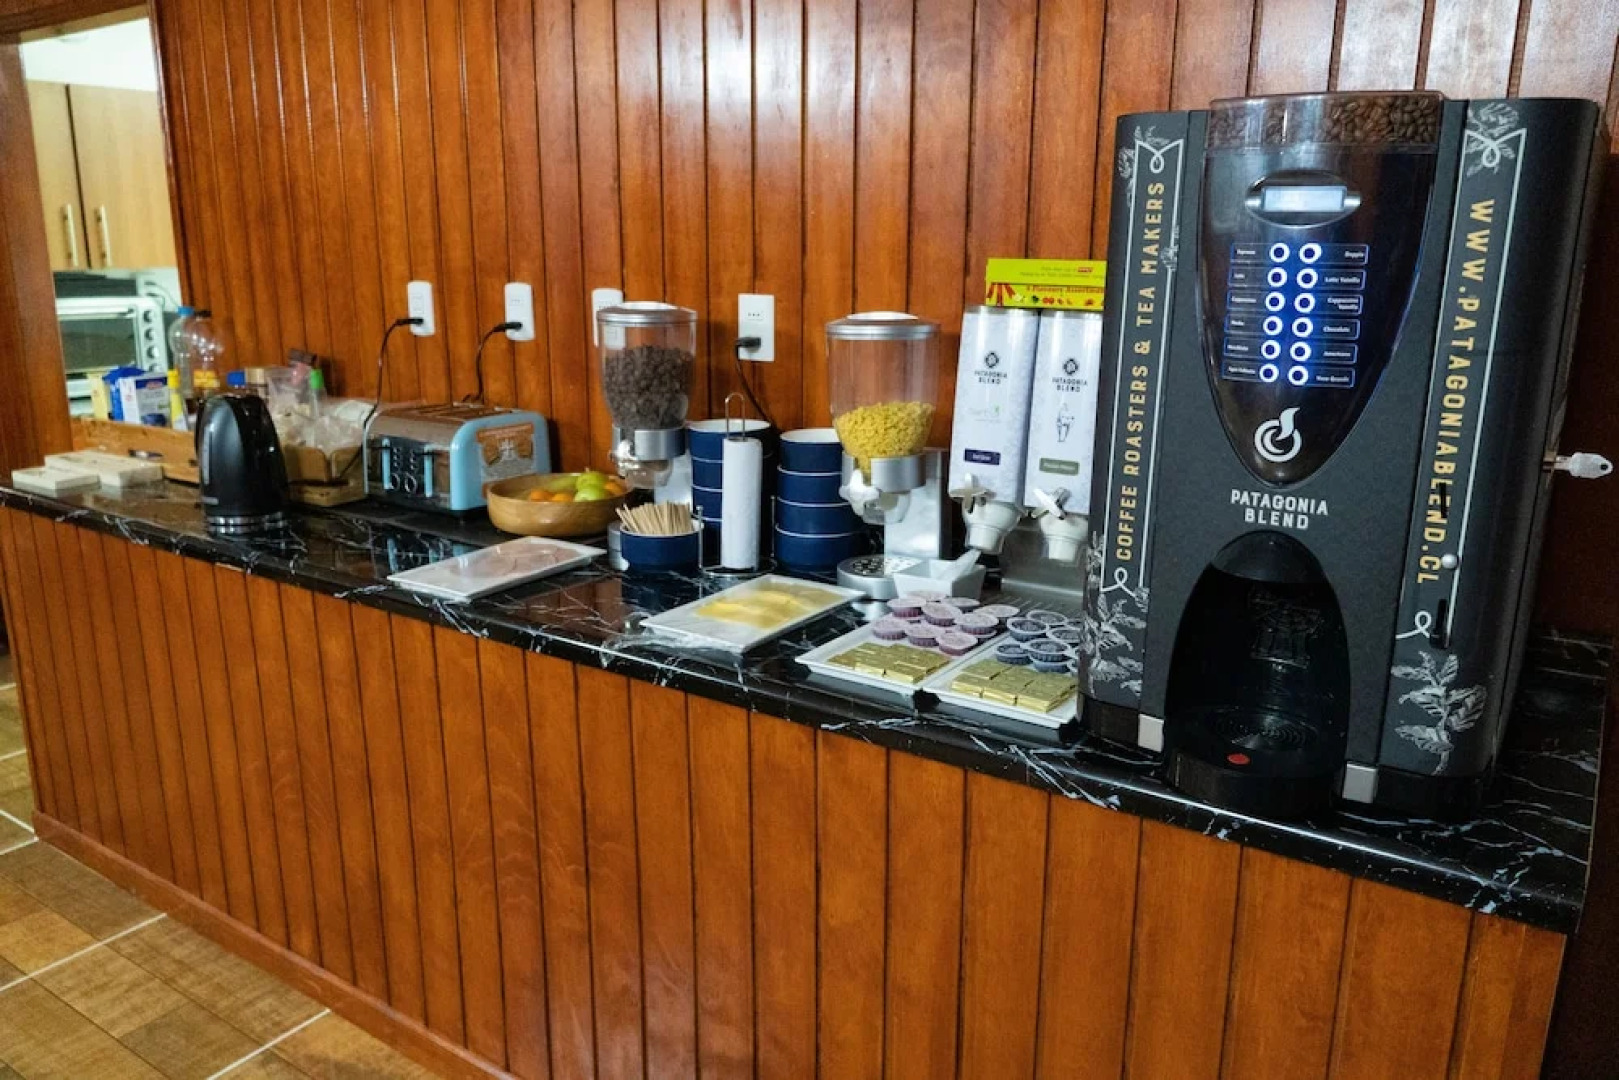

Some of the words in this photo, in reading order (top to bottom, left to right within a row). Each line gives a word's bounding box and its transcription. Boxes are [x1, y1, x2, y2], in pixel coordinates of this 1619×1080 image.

[1141, 182, 1165, 274] MAKERS
[1137, 285, 1156, 327] TEA
[1136, 339, 1151, 354] &
[974, 370, 1008, 379] PATAGONIA
[978, 377, 1001, 385] BLEND
[1052, 377, 1088, 386] PATAGONIA
[1417, 199, 1495, 584] WWW.PATAGONIABLEND.CL
[1124, 365, 1149, 476] ROASTERS
[1231, 488, 1329, 516] PATAGONIA
[1117, 485, 1137, 561] COFFEE
[1244, 507, 1309, 530] BLEND
